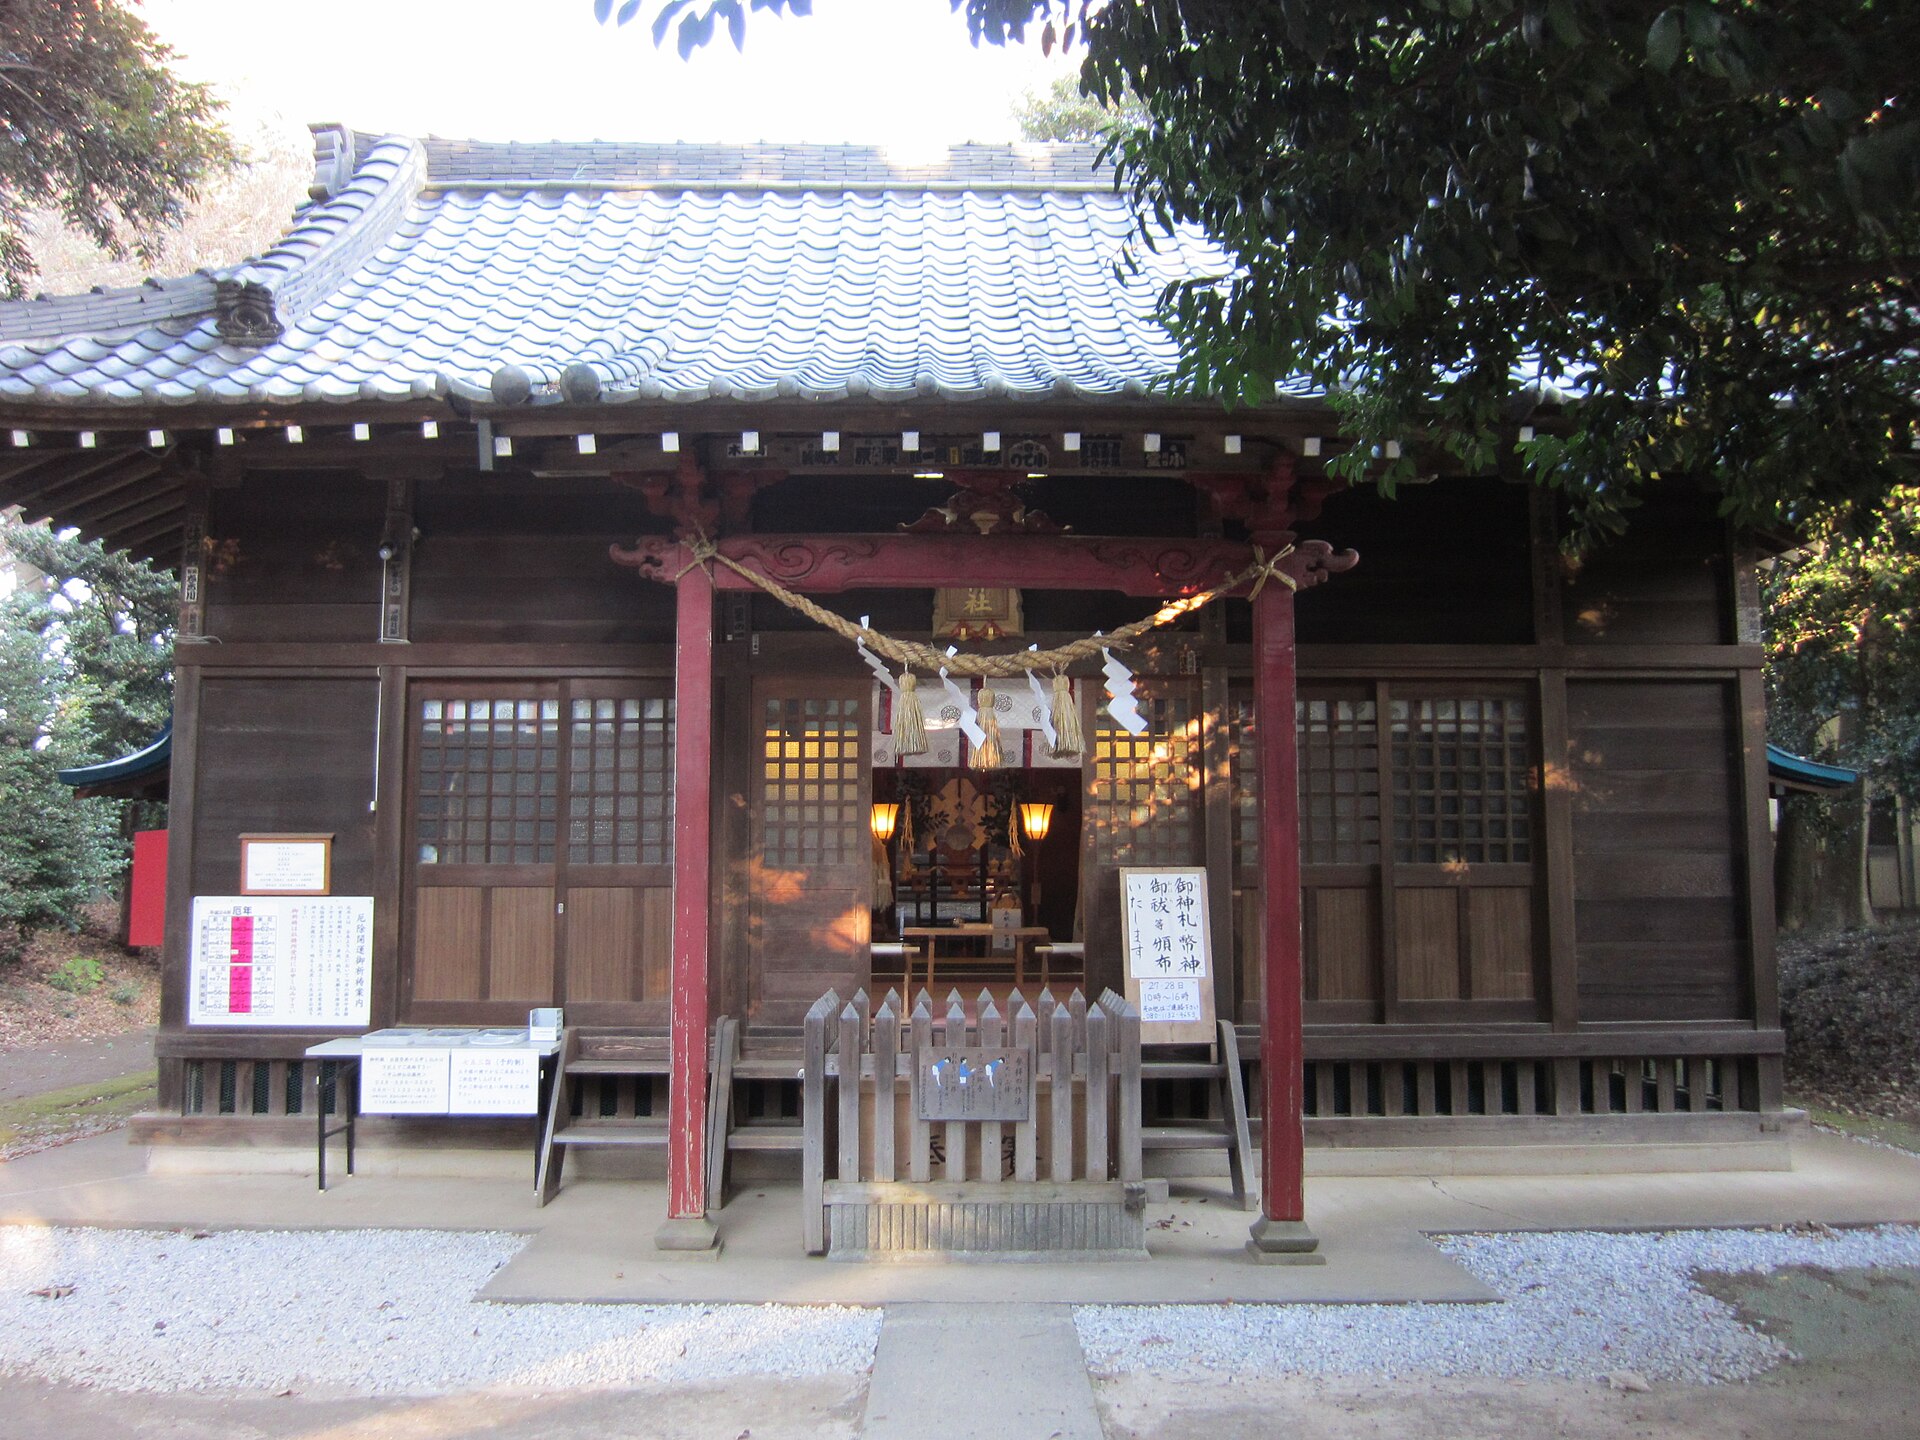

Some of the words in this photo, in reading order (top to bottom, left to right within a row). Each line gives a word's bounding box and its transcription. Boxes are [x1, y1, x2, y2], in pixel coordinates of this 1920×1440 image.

[963, 588, 993, 615] 社
[1128, 882, 1145, 961] いたします
